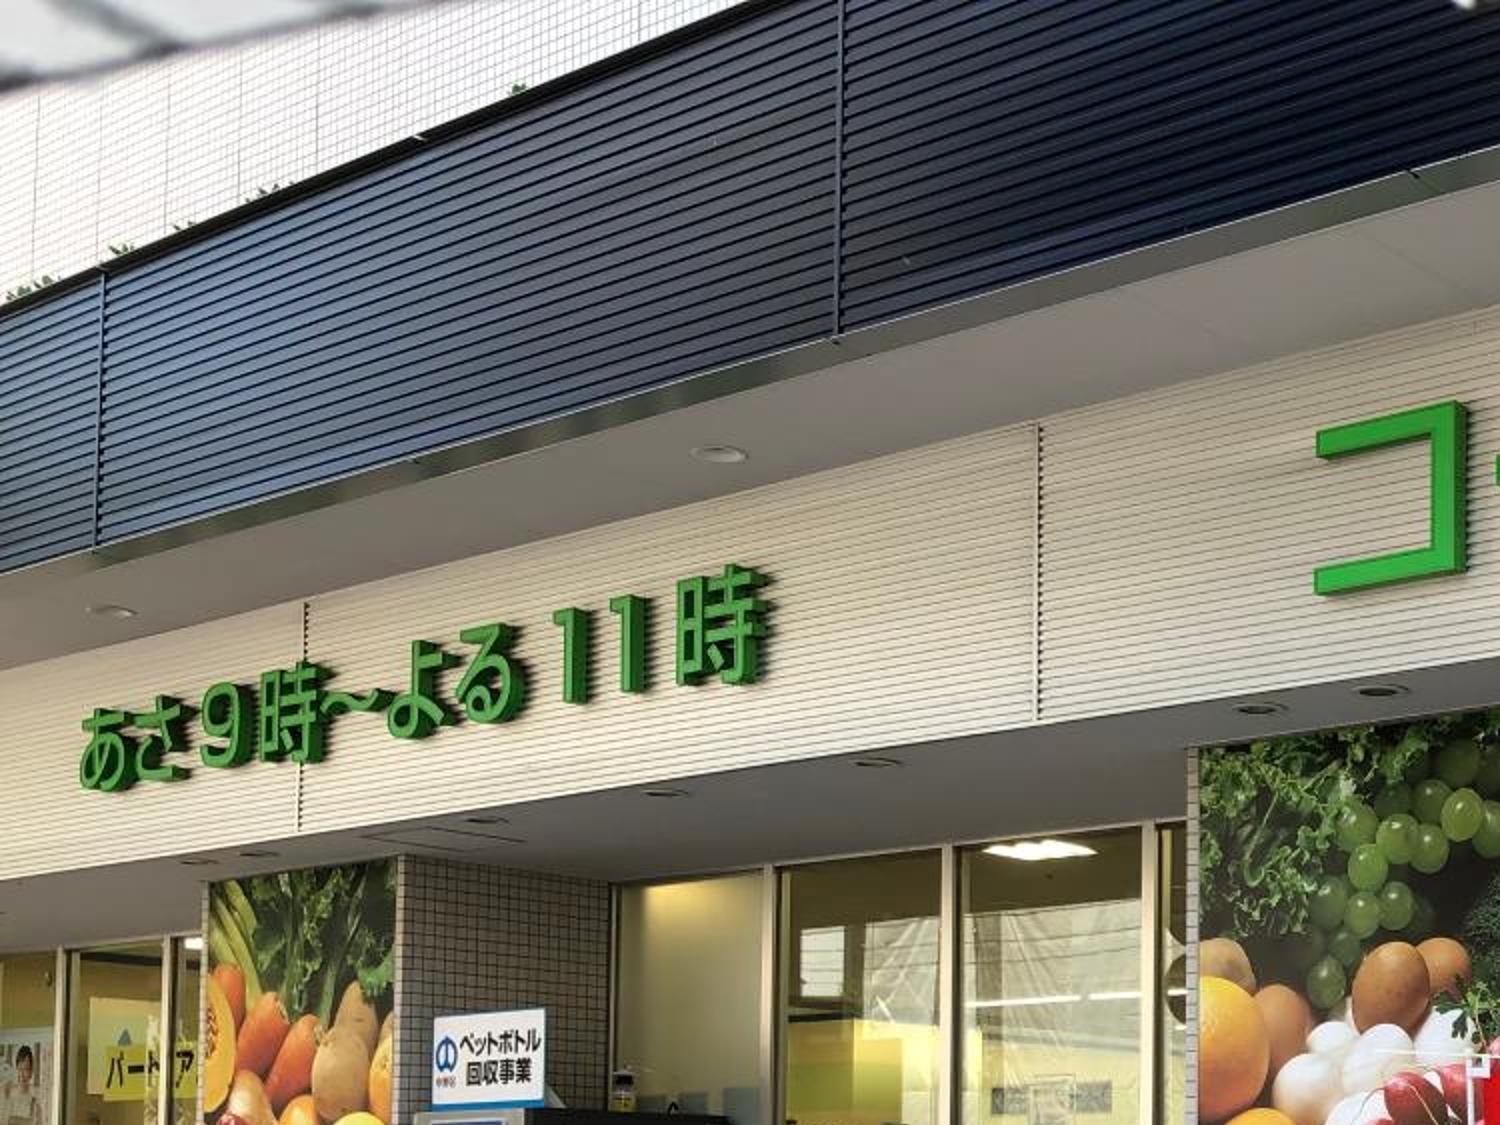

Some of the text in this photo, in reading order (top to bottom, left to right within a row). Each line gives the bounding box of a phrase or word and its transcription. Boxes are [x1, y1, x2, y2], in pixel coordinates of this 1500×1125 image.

[459, 1028, 541, 1056] ペットボトル
[466, 1058, 532, 1086] 回収事業
